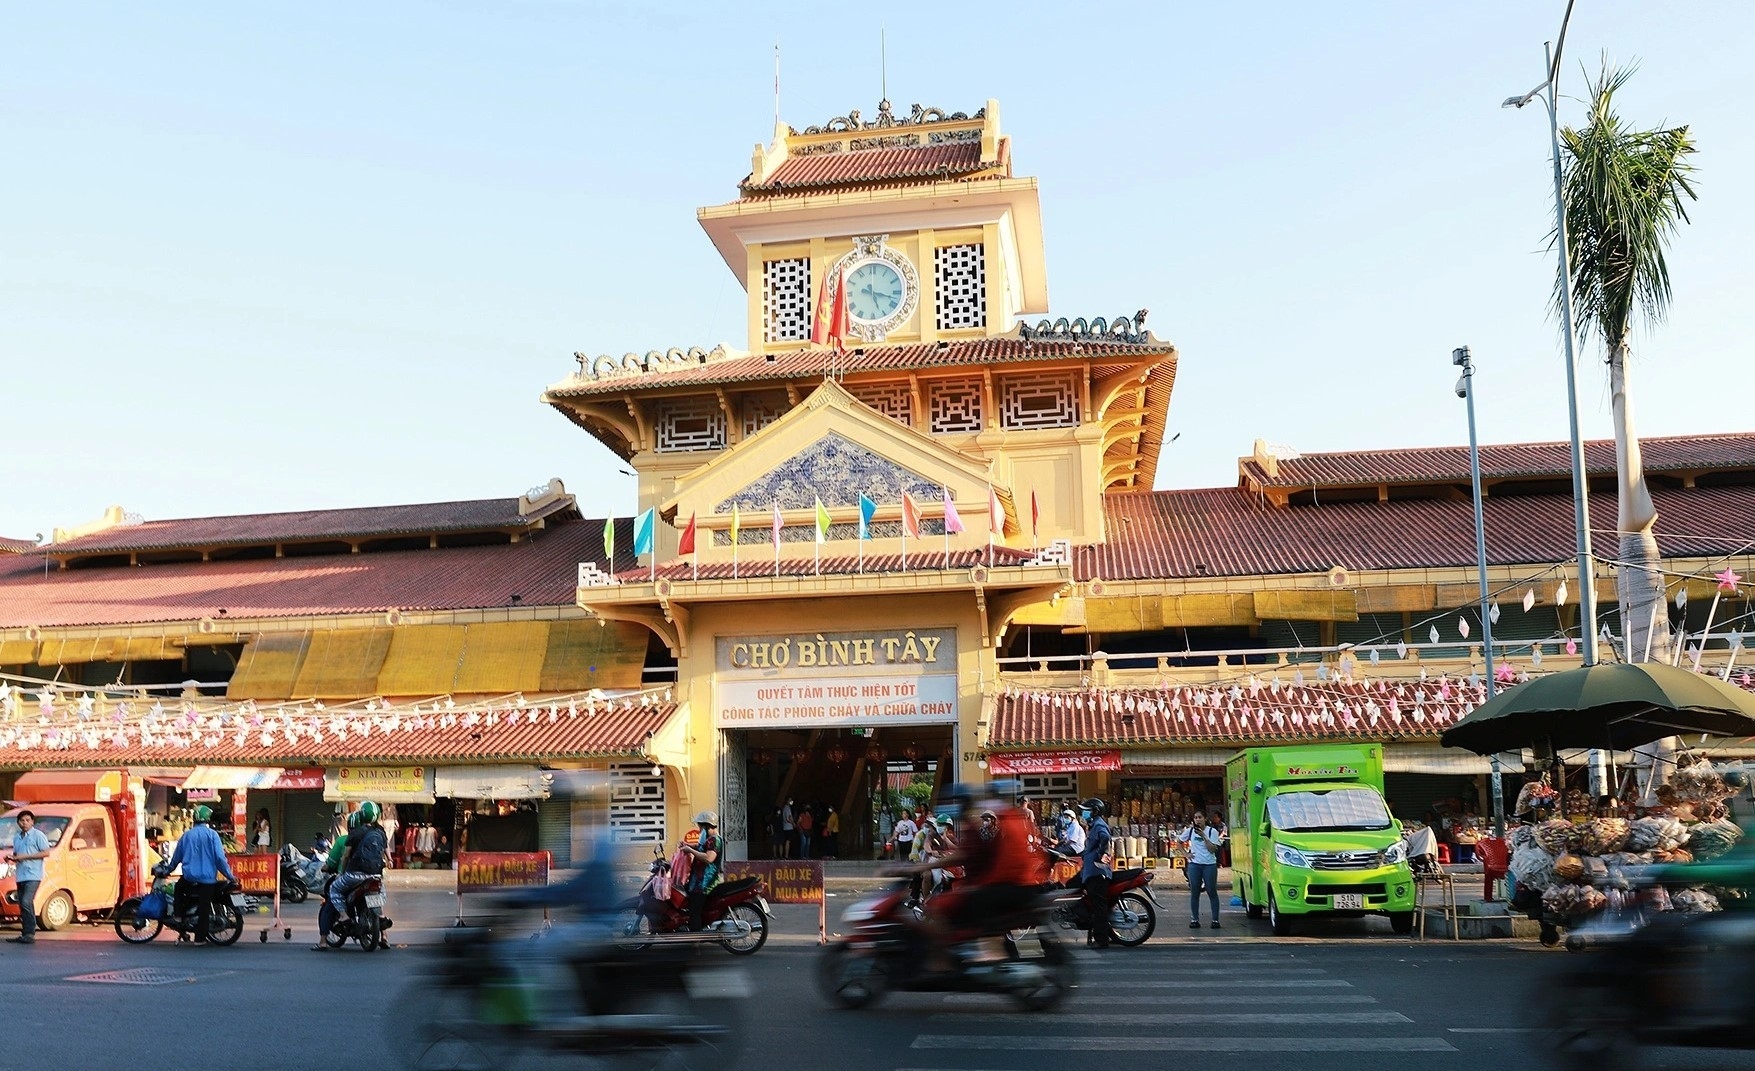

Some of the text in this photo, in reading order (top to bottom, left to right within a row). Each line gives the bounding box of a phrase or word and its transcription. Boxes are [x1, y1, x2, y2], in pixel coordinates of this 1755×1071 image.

[731, 631, 942, 670] CHỢ BÌNH TÂY
[757, 680, 916, 701] QUYẾT TÂM THỰC HIỆN TỐT
[722, 706, 754, 720] CÔNG
[758, 705, 780, 719] TÁC
[784, 704, 825, 718] PHÒNG
[864, 703, 880, 716] VÀ
[884, 702, 917, 716] CHỮA
[920, 701, 953, 715] CHÁY
[257, 861, 268, 873] XE
[460, 856, 495, 885] CẤM
[526, 861, 538, 872] XE
[799, 868, 812, 881] XE
[775, 885, 822, 899] MUA BÁN
